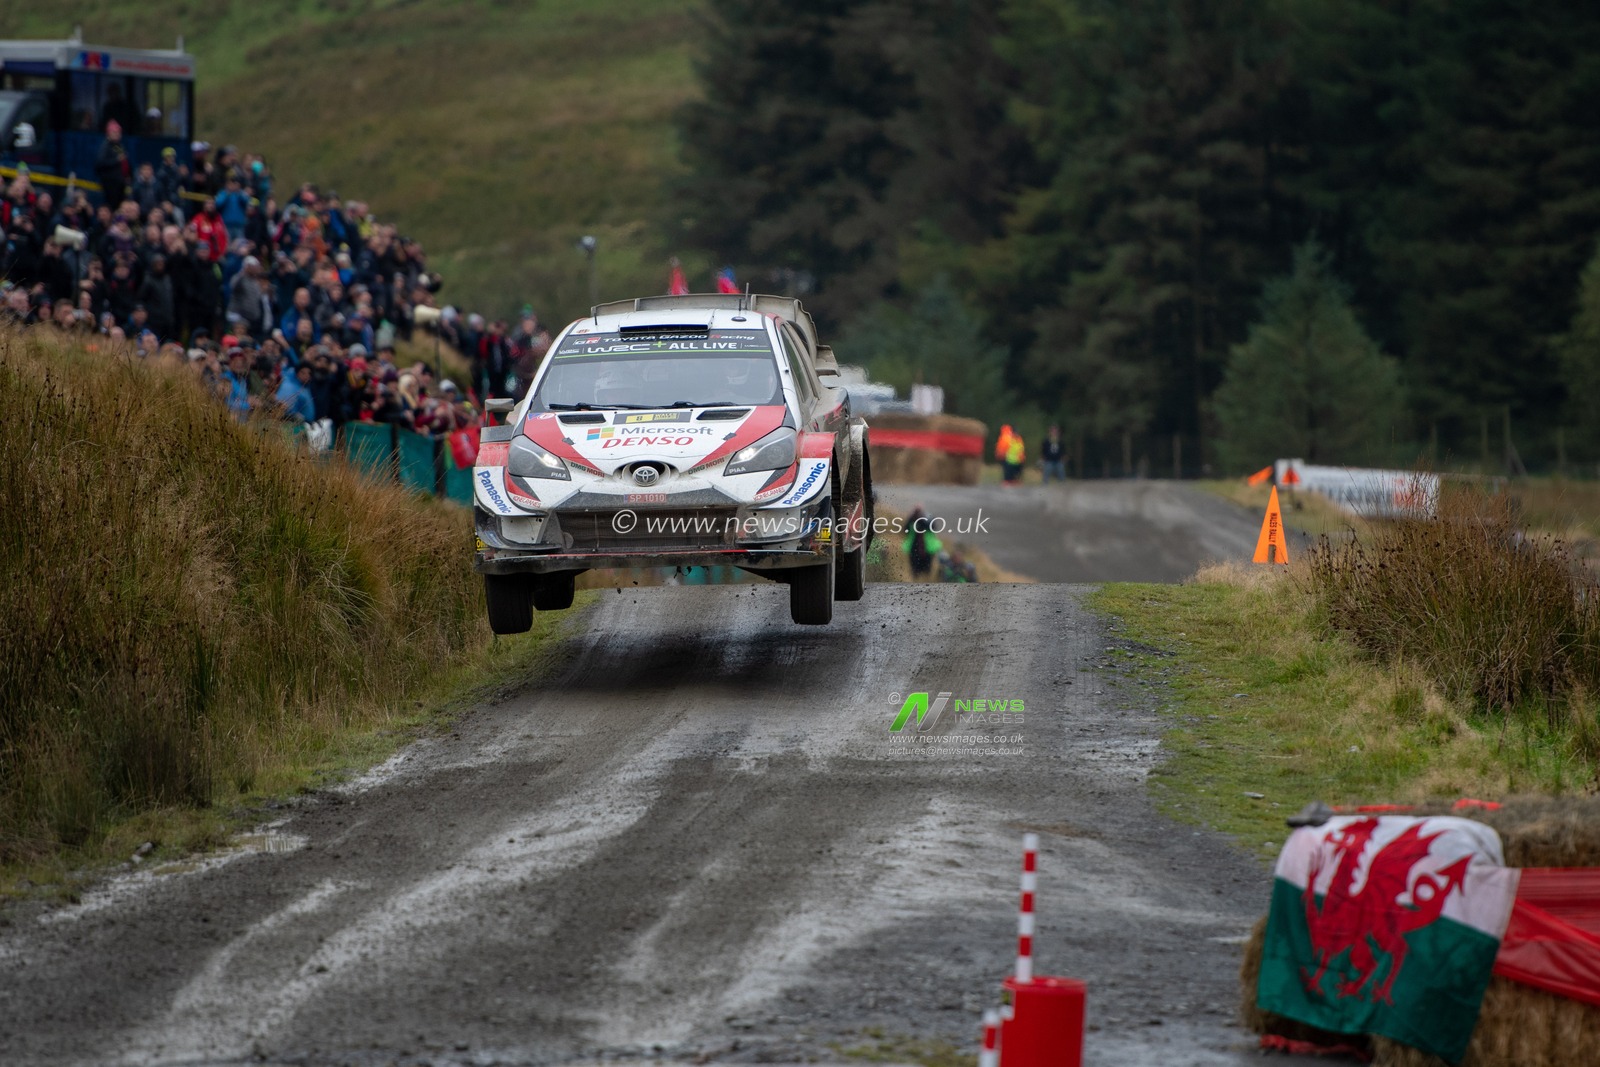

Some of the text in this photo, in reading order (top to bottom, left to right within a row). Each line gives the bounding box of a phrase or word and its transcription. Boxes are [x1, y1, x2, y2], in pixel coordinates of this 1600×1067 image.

[603, 335, 656, 343] TOYOTA
[668, 342, 699, 350] ALL
[621, 426, 714, 436] Microsoft
[602, 436, 694, 449] DENSO
[570, 461, 605, 478] DMG MORI
[687, 457, 725, 475] DMG MORI
[728, 466, 747, 474] PIAA
[550, 471, 567, 479] PIAA
[782, 462, 826, 506] Panasonic
[477, 470, 513, 514] Panasonic
[629, 494, 666, 502] SP 1010
[1268, 512, 1278, 543] WALES RALLY
